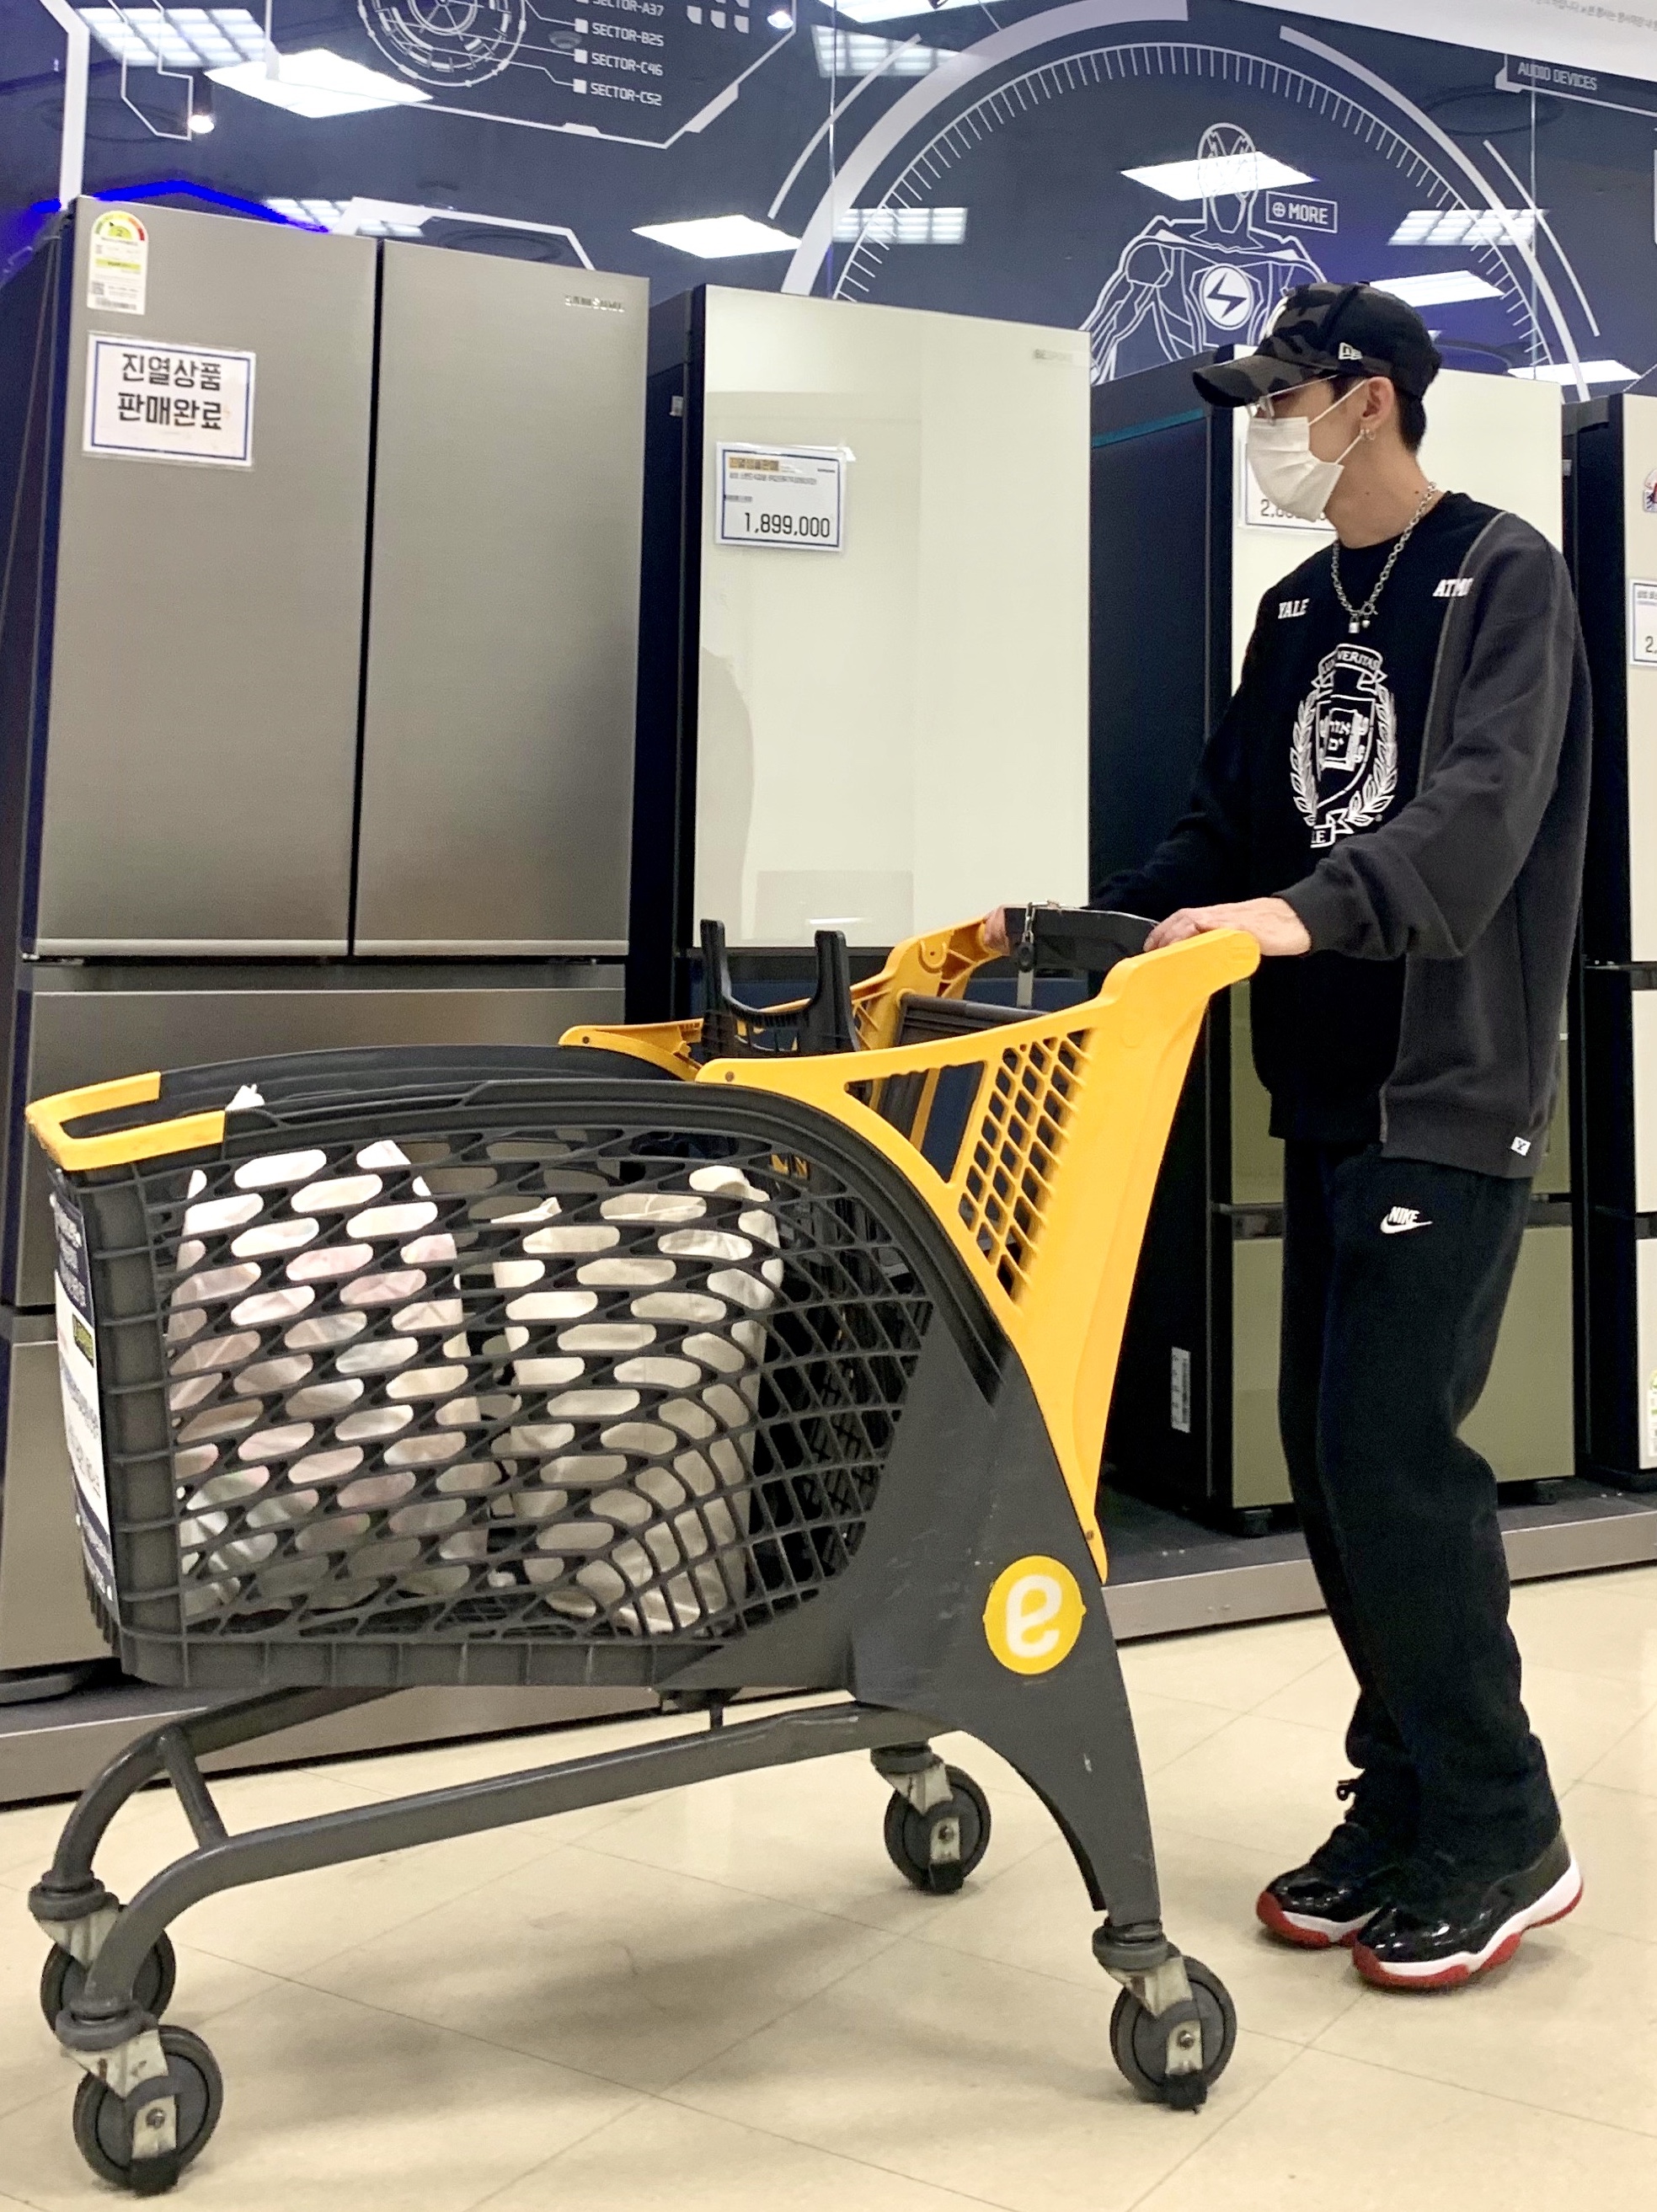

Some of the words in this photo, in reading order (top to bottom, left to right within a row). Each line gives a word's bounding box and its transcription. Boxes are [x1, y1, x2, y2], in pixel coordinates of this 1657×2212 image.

[591, 22, 665, 47] SECTOR-B25
[591, 52, 664, 77] SECTOR-C46
[1518, 61, 1551, 81] AUDIO
[1553, 69, 1597, 90] DEVICES
[591, 83, 662, 106] SECTOR-C52
[1288, 202, 1329, 225] MORE
[122, 353, 222, 391] 진열상품
[118, 392, 222, 430] 판매완료
[744, 511, 831, 538] 1,899,000
[1277, 598, 1310, 619] YALE
[1387, 1205, 1420, 1224] NIKE
